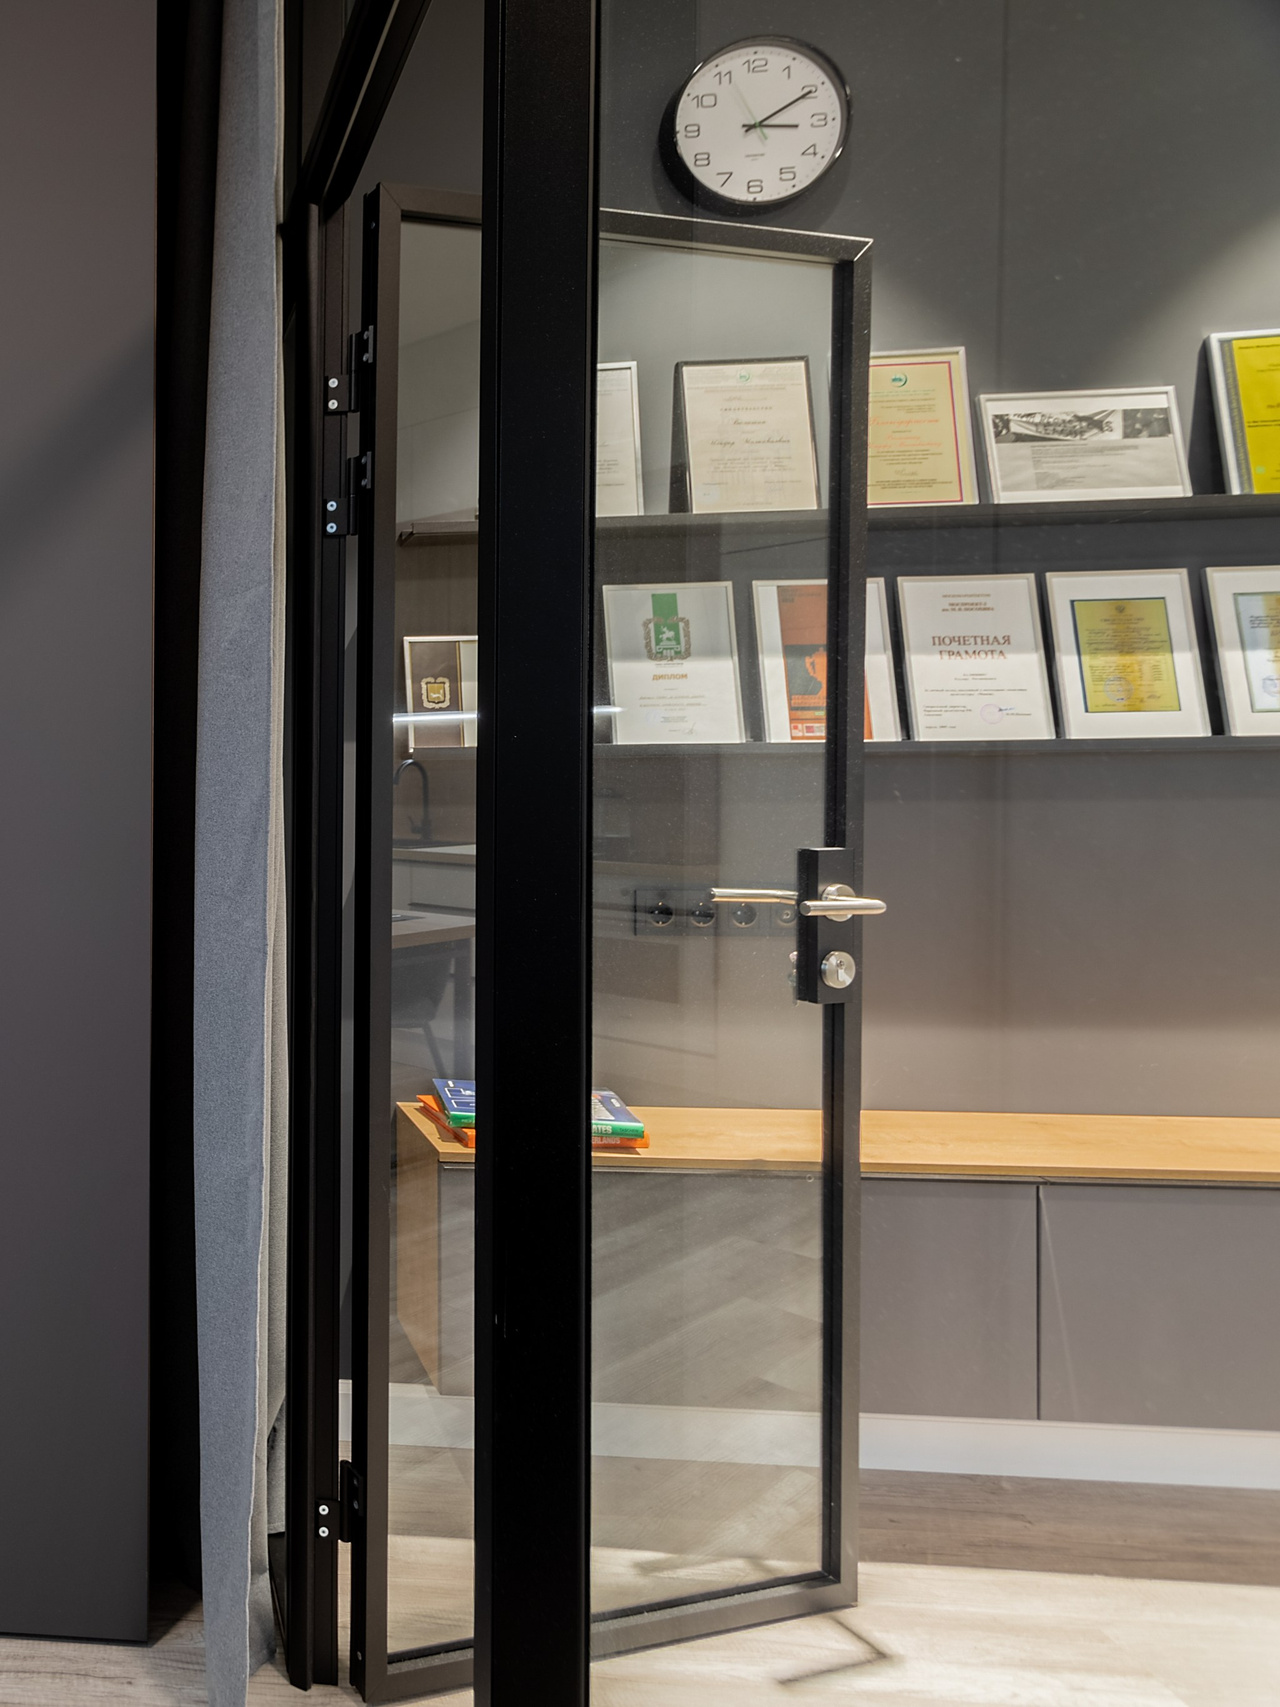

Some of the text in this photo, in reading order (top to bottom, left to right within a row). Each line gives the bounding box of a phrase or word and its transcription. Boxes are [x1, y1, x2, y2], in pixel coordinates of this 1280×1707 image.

[742, 58, 768, 73] 12
[782, 65, 791, 80] 1
[713, 70, 733, 85] 11
[801, 84, 818, 99] 2
[691, 93, 717, 109] 10
[810, 112, 828, 128] 3
[684, 123, 701, 139] 9
[801, 143, 819, 157] 4
[694, 152, 711, 167] 8
[716, 171, 734, 187] 7
[779, 166, 797, 182] 5
[747, 179, 763, 194] 6
[932, 635, 1011, 646] ПОЧЕТНАЯ
[939, 649, 1007, 660] ГРАМОТА
[652, 673, 688, 681] ДИПЛОМ
